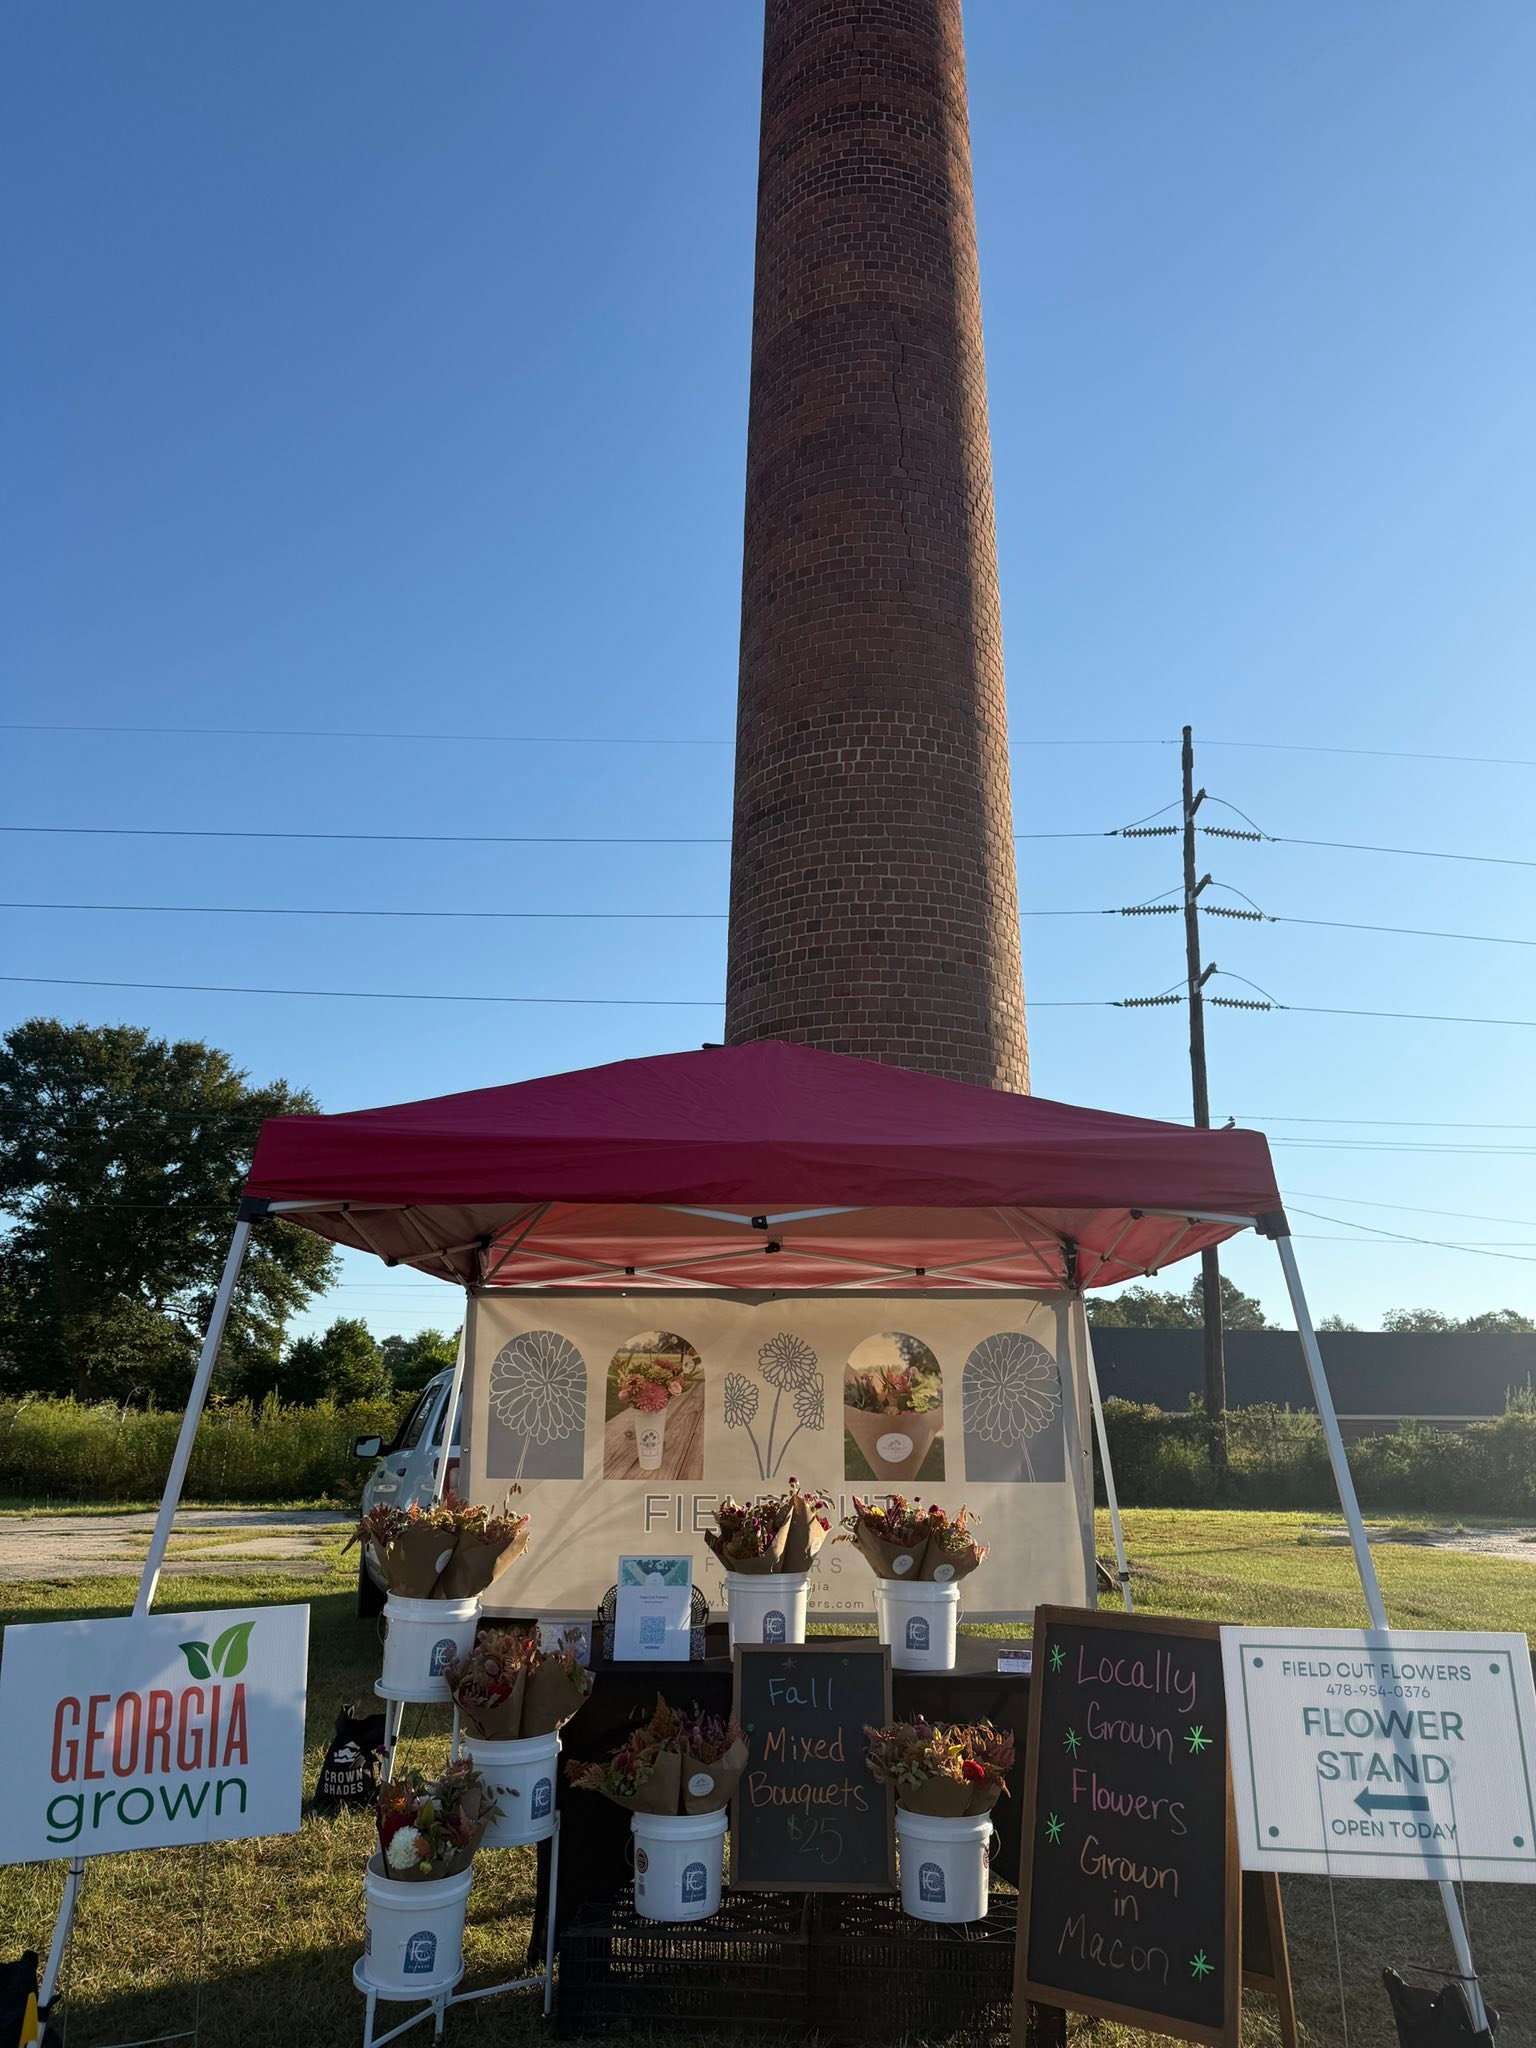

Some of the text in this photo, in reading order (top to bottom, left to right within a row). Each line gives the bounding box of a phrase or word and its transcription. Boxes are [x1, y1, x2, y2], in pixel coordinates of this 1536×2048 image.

[1077, 1644, 1198, 1713] Locally
[1282, 1661, 1472, 1681] FIELD CUT FLOWERS
[767, 1677, 833, 1711] Fall
[1326, 1683, 1431, 1699] 478-954-0376
[50, 1683, 249, 1784] GEORGIA
[1087, 1700, 1174, 1767] Grown
[1302, 1707, 1465, 1741] FLOWER
[763, 1727, 846, 1763] Mixed
[324, 1767, 363, 1784] CROWN
[1317, 1750, 1450, 1784] STAND
[323, 1781, 364, 1795] SHADES
[747, 1771, 870, 1816] Bouquets
[1072, 1767, 1188, 1836] Flowers
[46, 1778, 247, 1844] grown
[786, 1813, 843, 1865] $25
[1331, 1819, 1457, 1841] OPEN TODAY
[1079, 1834, 1179, 1898] Grown
[1114, 1890, 1139, 1921] in
[1057, 1913, 1169, 1985] Macon
